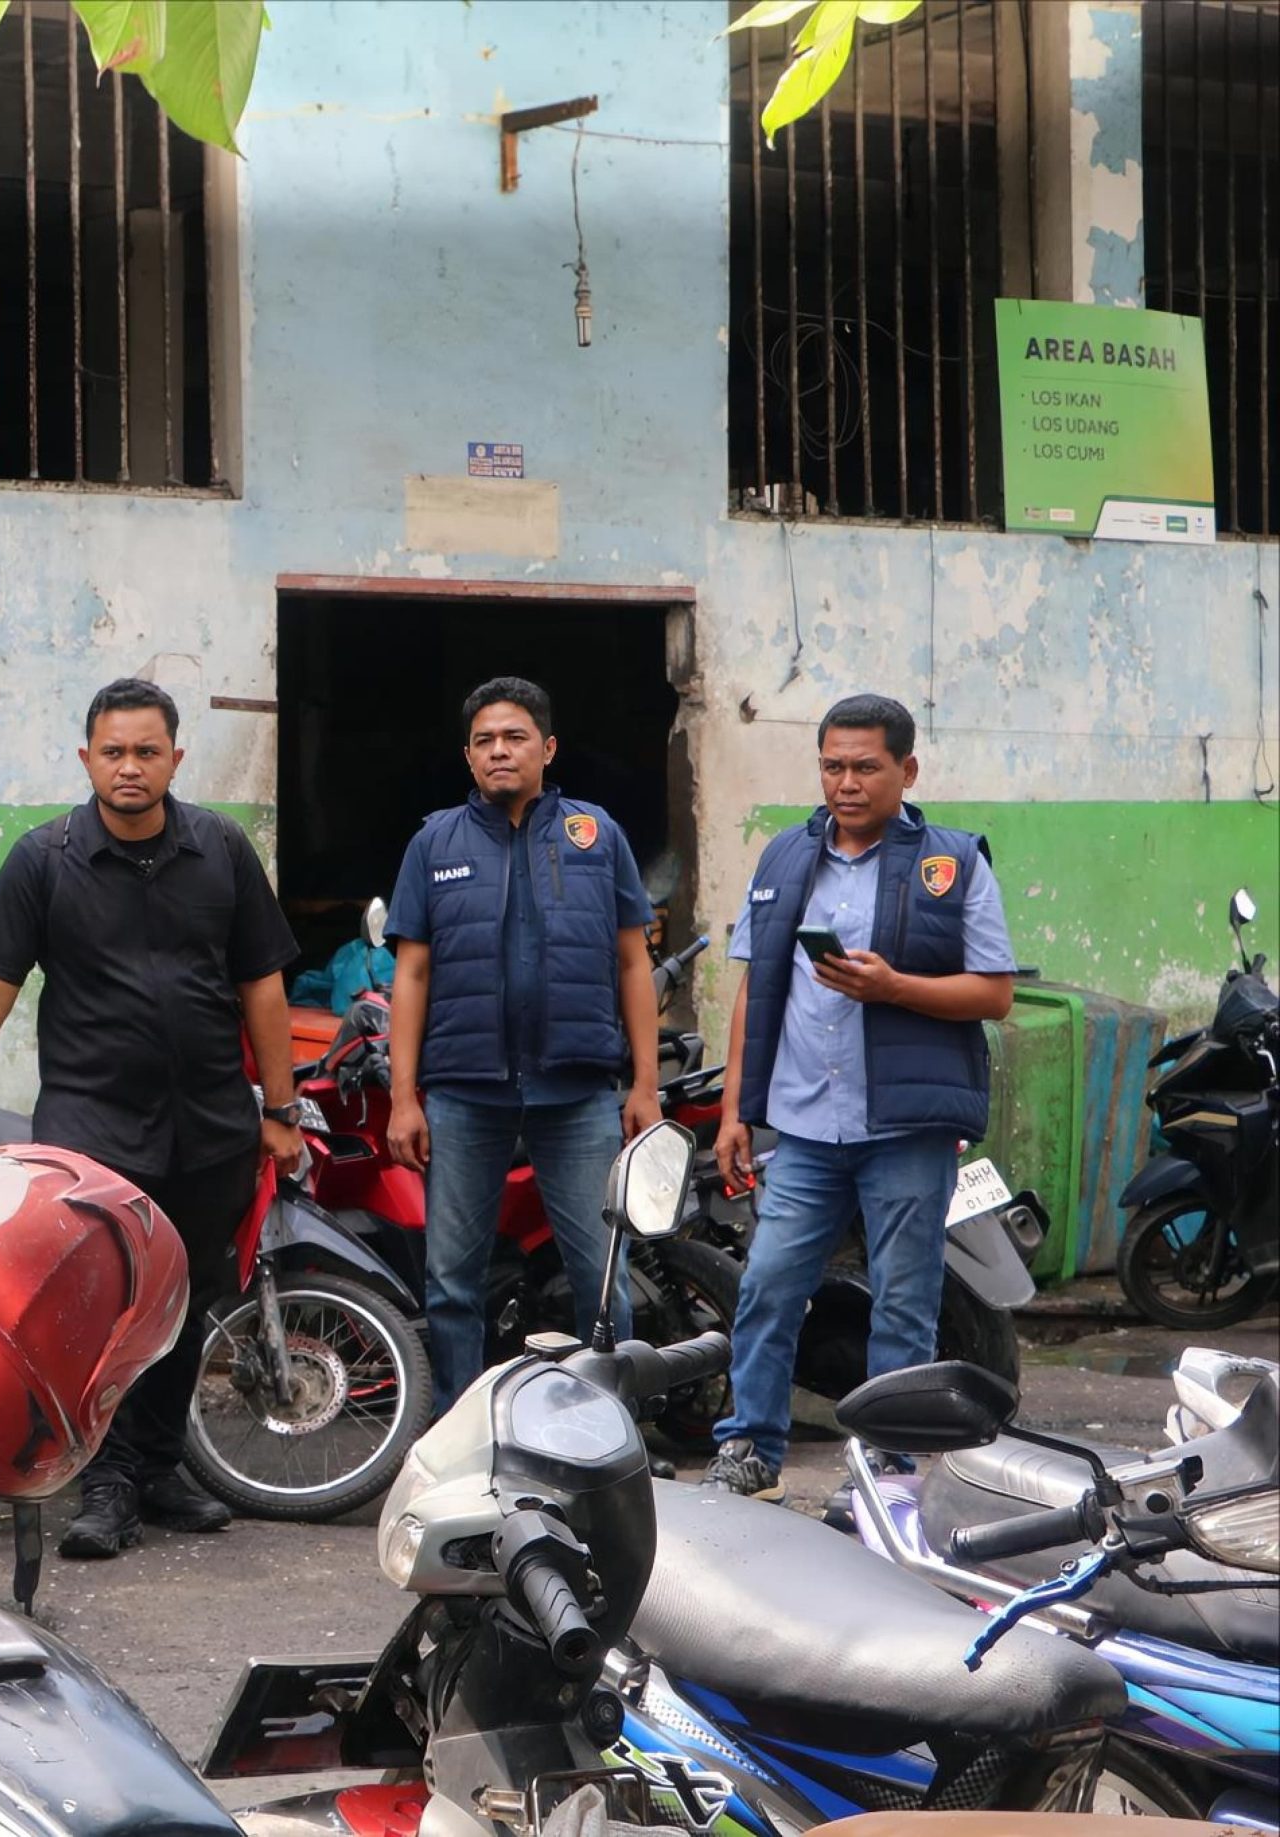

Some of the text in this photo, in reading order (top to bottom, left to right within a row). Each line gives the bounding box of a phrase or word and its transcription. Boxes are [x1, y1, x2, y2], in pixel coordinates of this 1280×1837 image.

[1025, 337, 1176, 372] AREA BASAH
[1032, 390, 1102, 408] LOS IKAN
[1033, 416, 1120, 436] LOS UDANG
[1034, 443, 1105, 461] LOS CUMI
[434, 865, 471, 882] HANS
